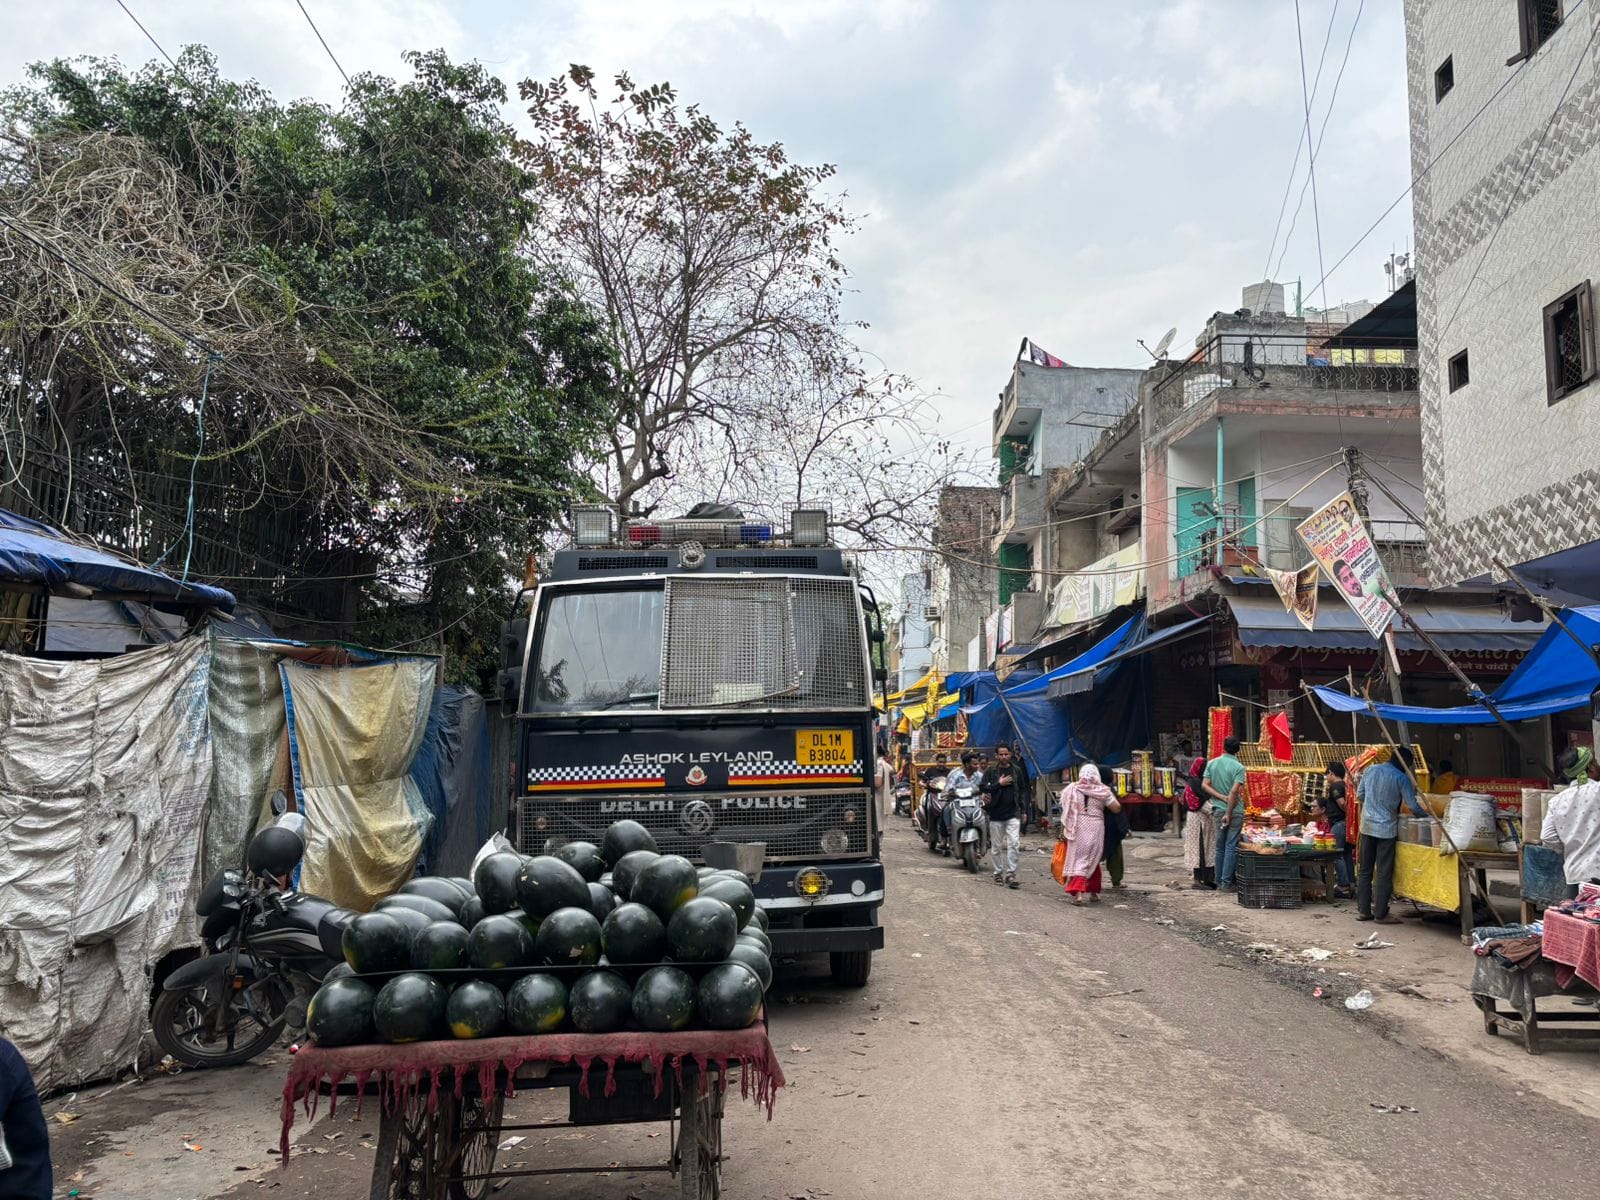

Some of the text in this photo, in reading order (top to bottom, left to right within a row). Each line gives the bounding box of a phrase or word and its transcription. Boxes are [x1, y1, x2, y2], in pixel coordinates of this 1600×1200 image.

[812, 733, 842, 746] DL1M
[620, 751, 773, 765] ASHOK LEYLAND
[809, 749, 846, 761] B3804
[600, 795, 807, 812] DELHI POLICE
